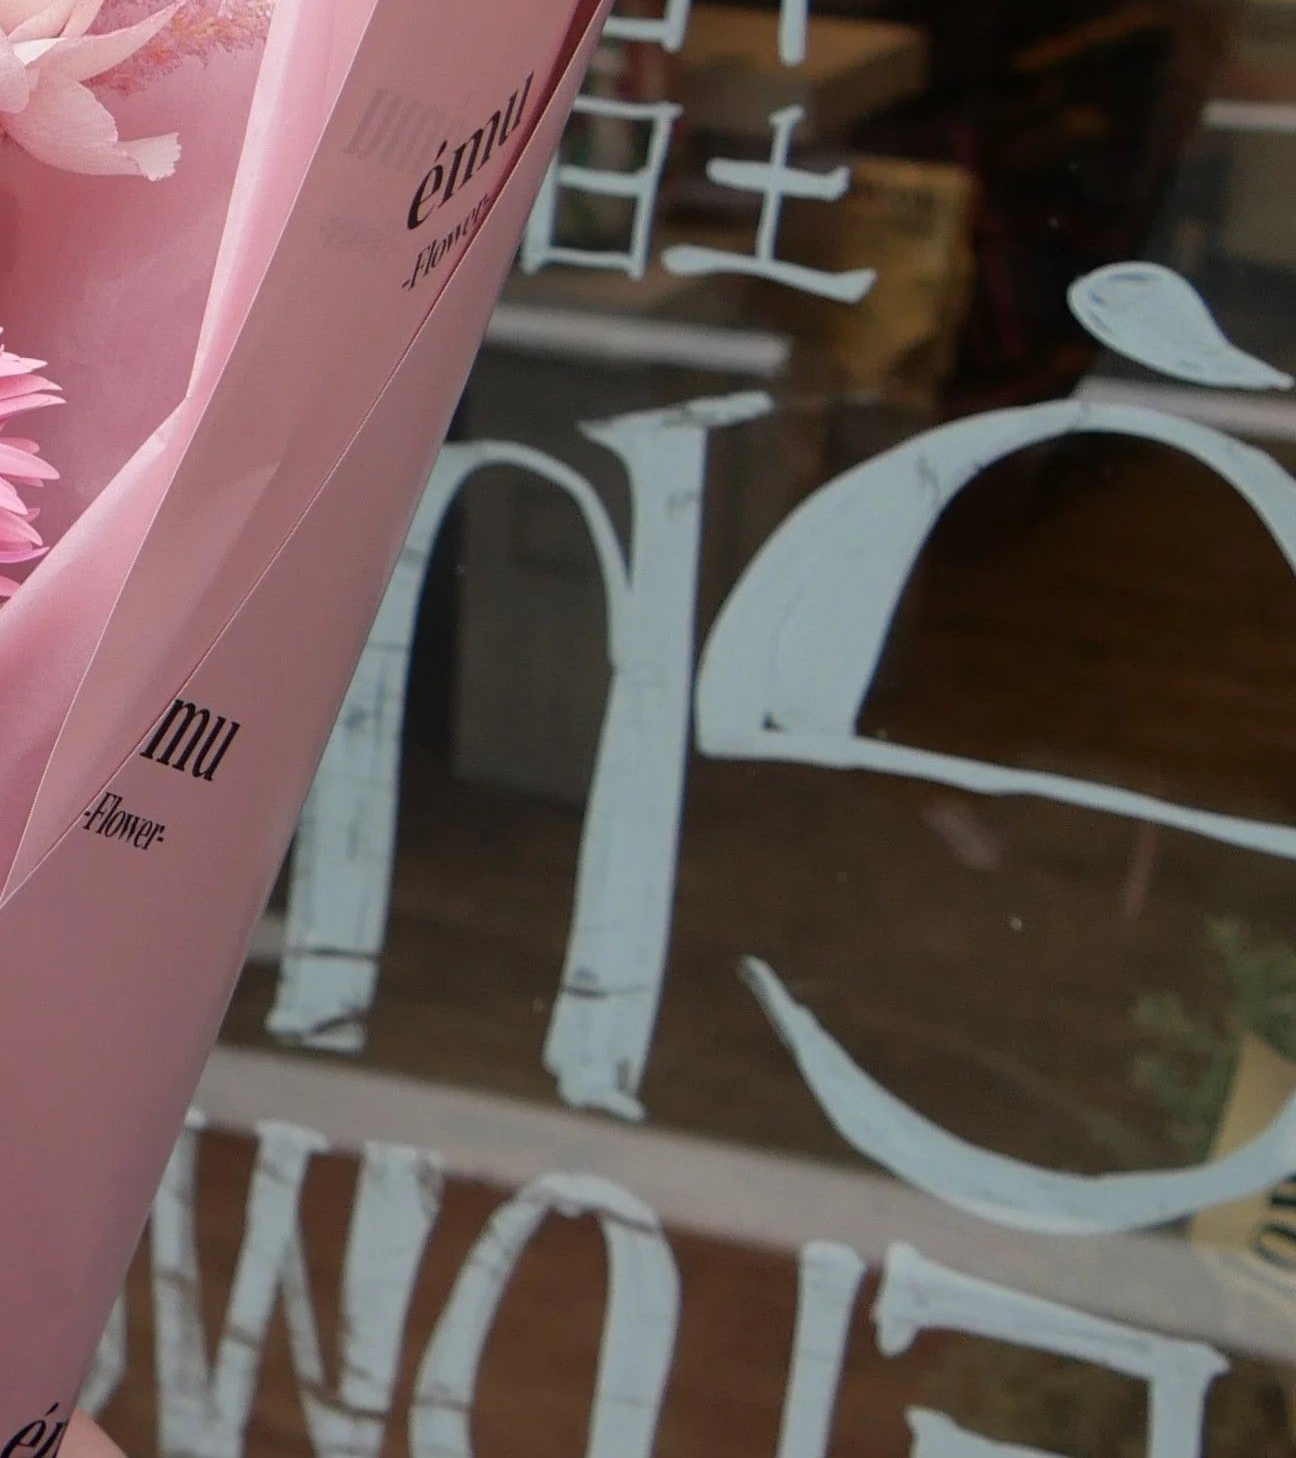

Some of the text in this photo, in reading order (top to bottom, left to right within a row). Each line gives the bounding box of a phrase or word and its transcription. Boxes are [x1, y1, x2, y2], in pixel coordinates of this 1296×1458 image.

[407, 70, 534, 230] ému
[139, 699, 241, 782] mu
[83, 792, 166, 850] -Flower-
